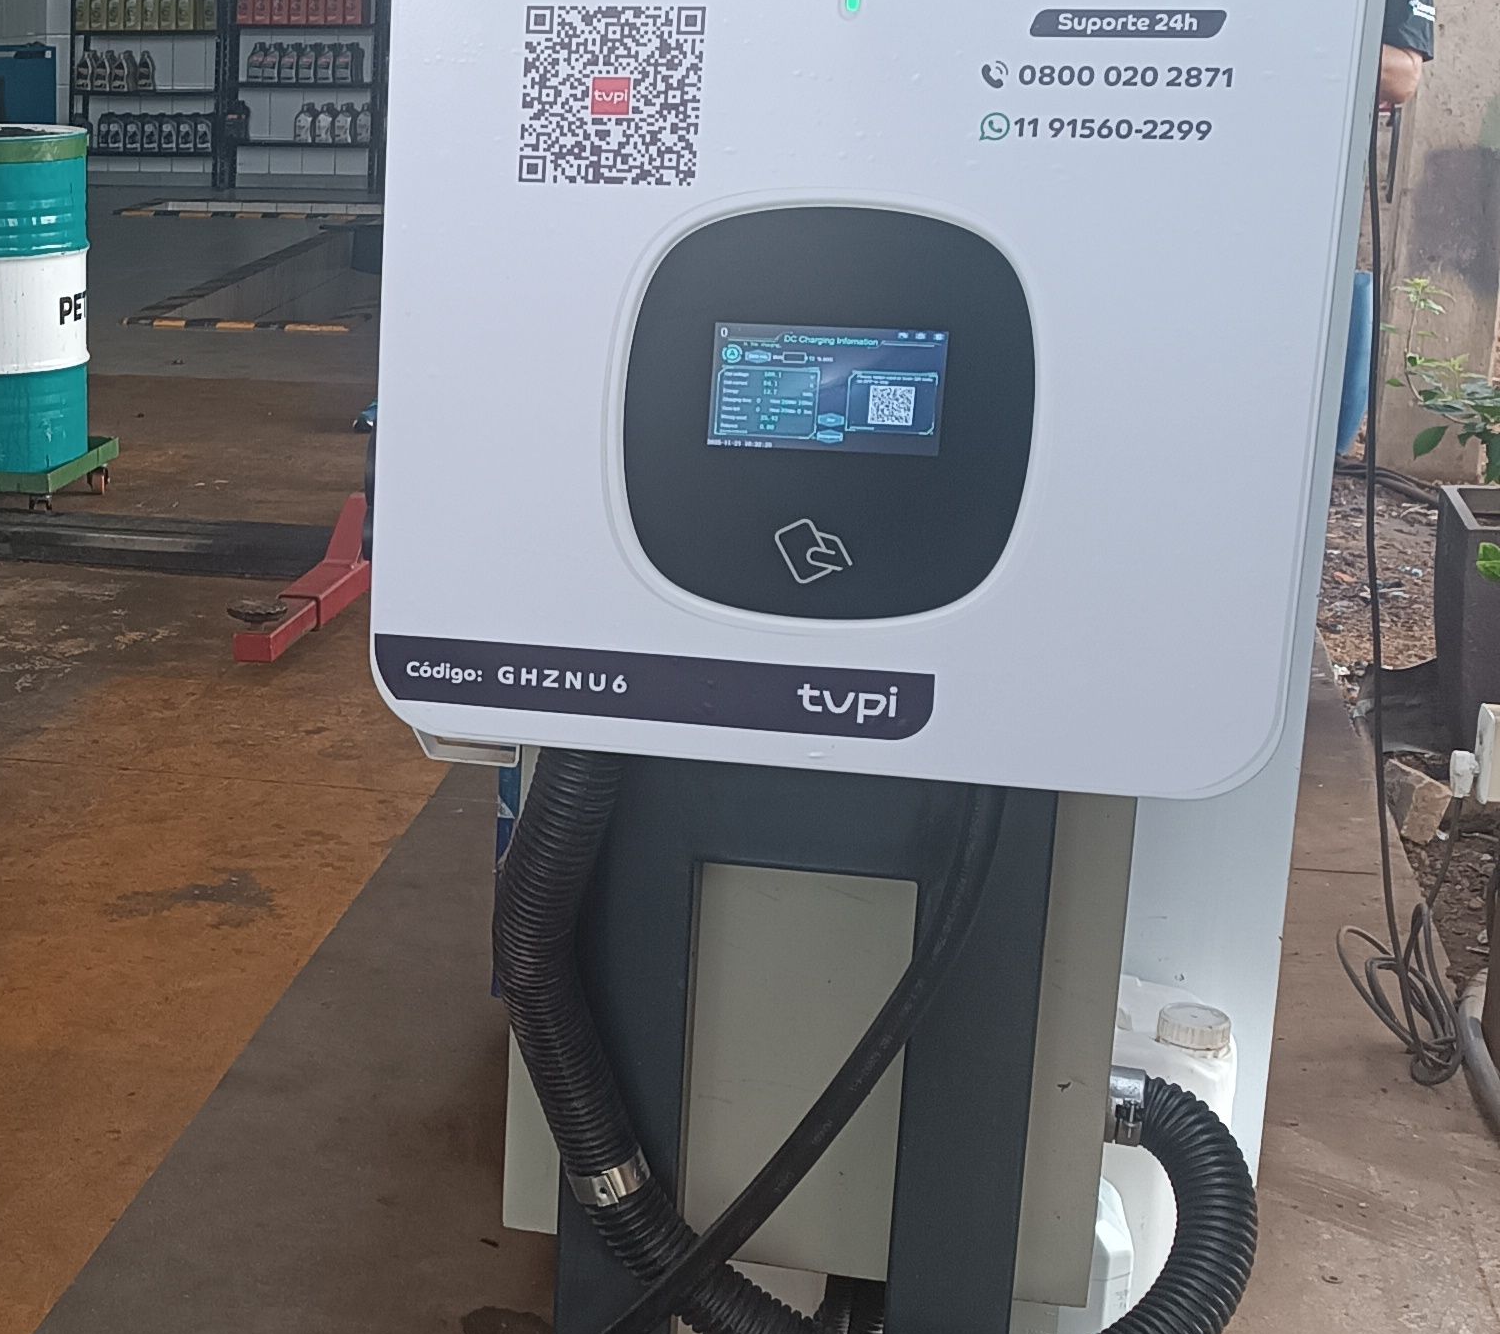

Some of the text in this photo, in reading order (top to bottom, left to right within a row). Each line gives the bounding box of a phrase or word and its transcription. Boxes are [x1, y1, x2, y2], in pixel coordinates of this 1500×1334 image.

[1057, 13, 1198, 34] Suporte 24h
[1018, 65, 1234, 88] 0800 020 2871
[1013, 117, 1212, 141] 11 91560-2299
[784, 334, 797, 343] DC
[799, 335, 835, 346] Charging
[405, 660, 483, 685] Código:
[497, 665, 629, 695] GHZNU6
